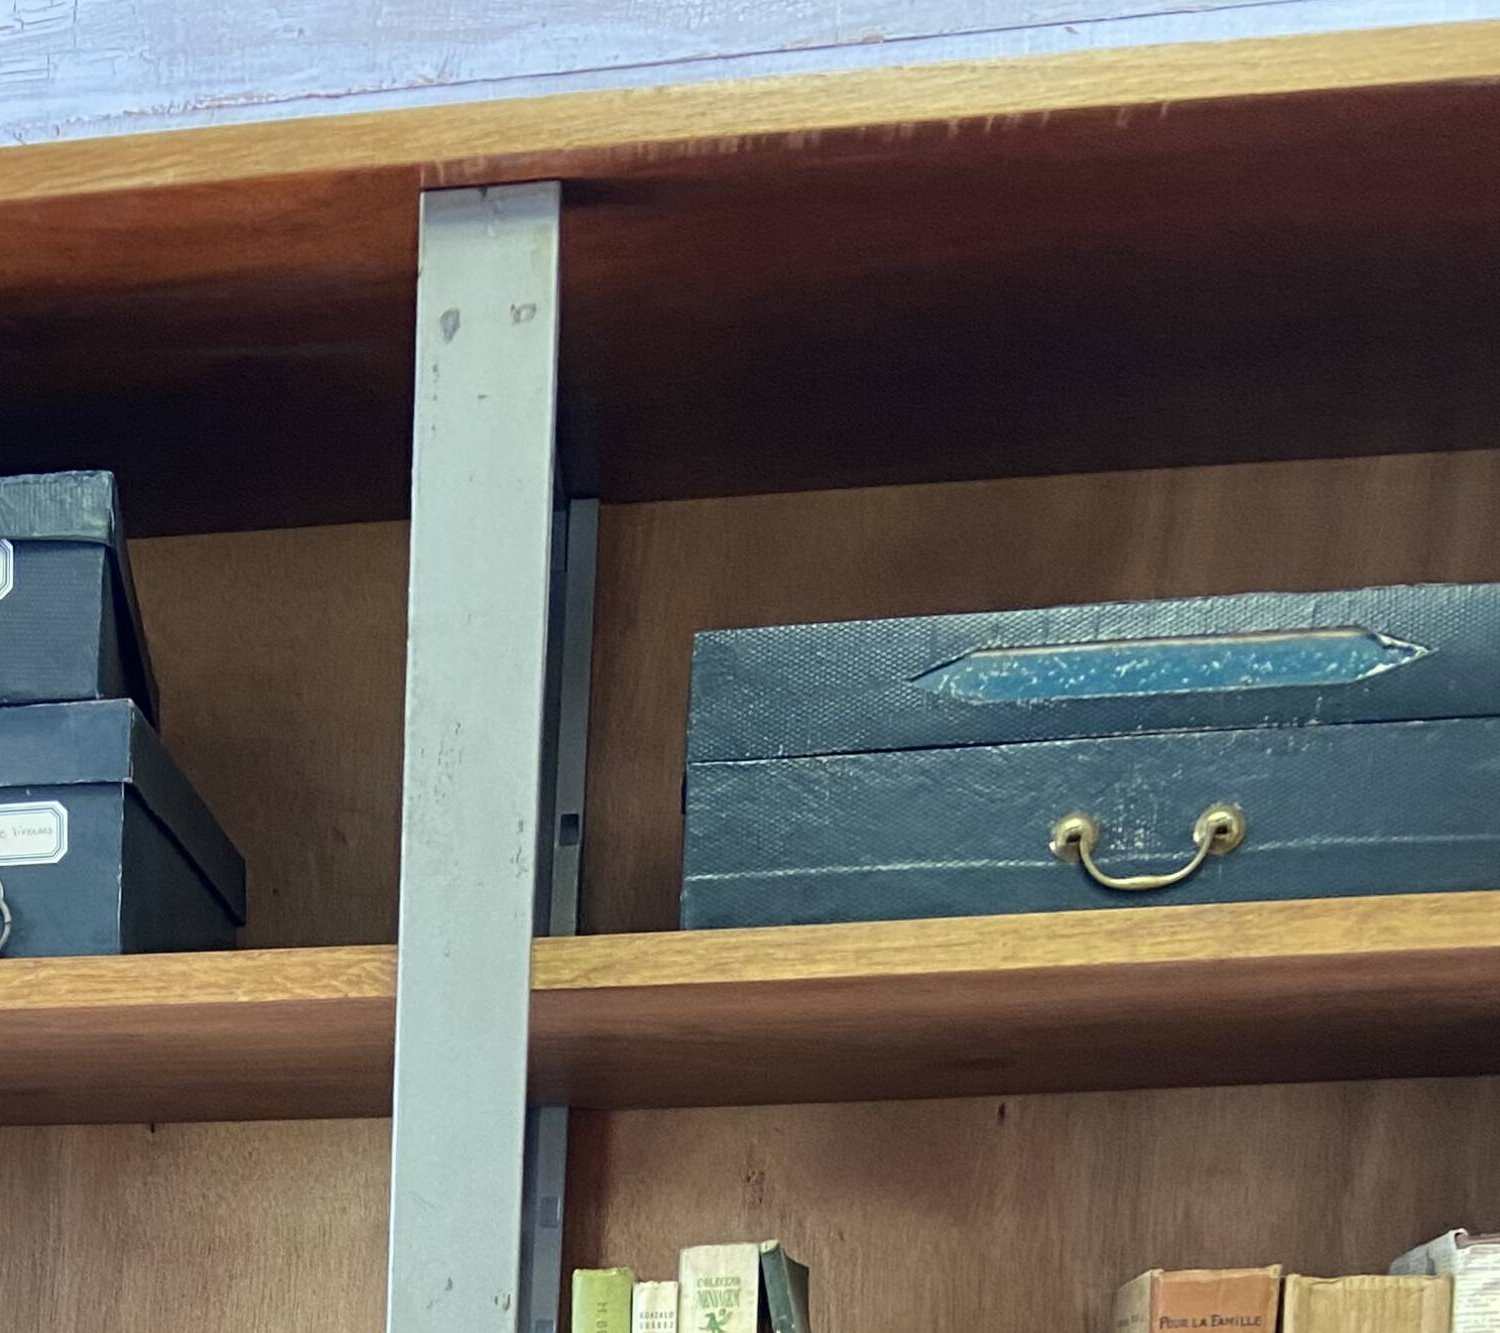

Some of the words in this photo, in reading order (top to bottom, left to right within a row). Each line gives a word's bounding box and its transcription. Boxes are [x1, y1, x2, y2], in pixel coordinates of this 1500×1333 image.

[1159, 1315, 1189, 1329] POUR
[1191, 1317, 1208, 1328] LA
[1210, 1314, 1262, 1328] FAMILLE
